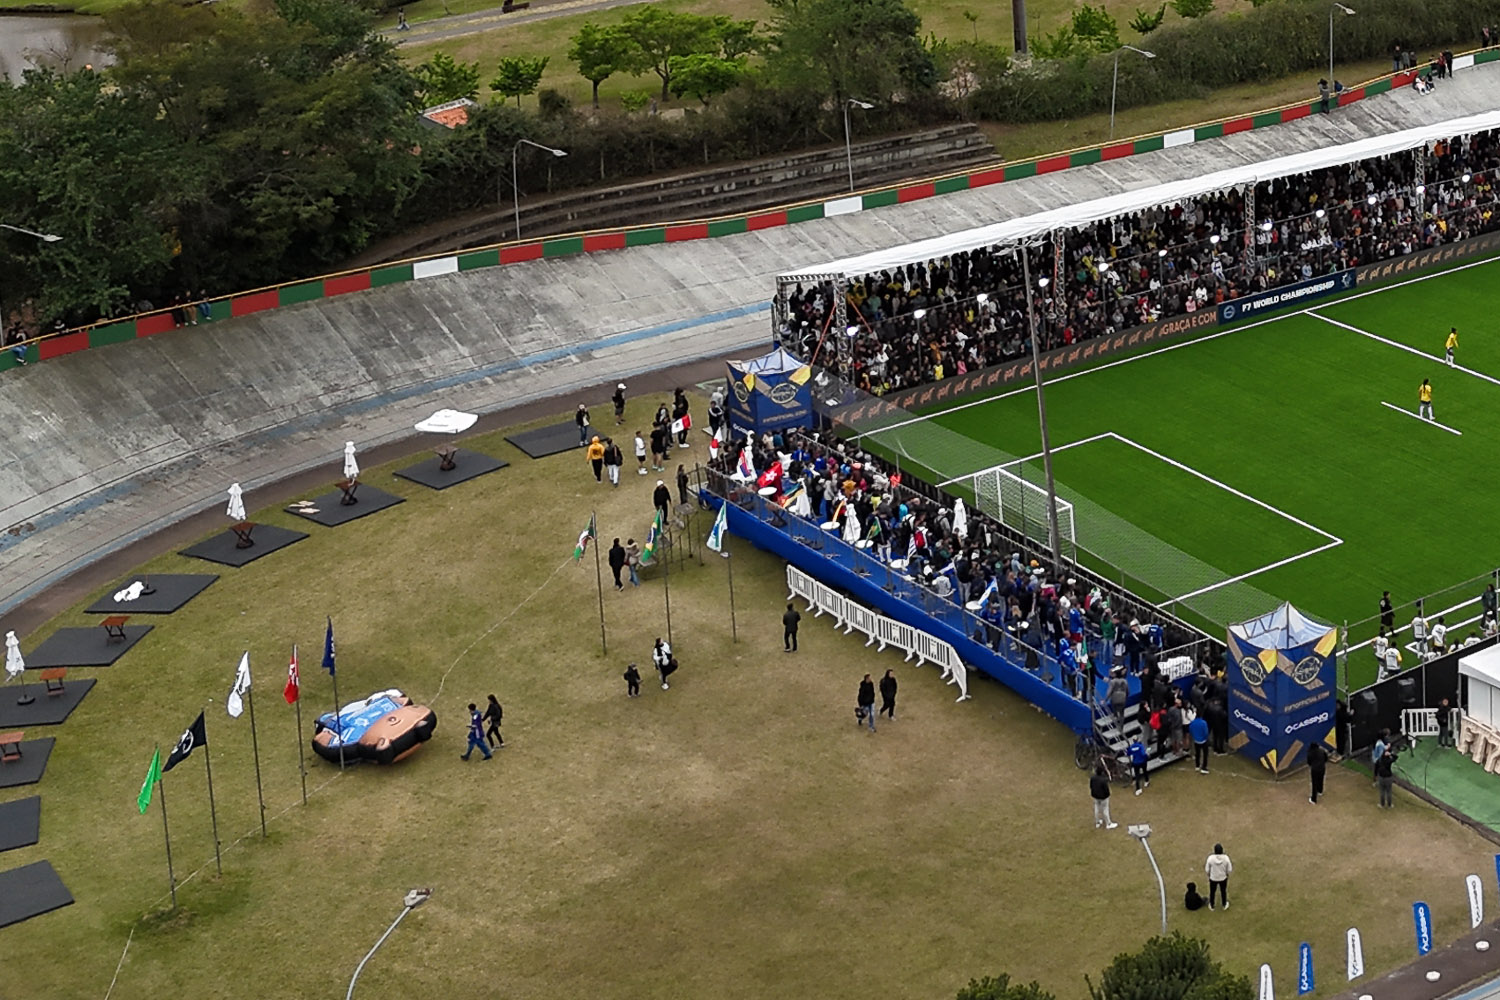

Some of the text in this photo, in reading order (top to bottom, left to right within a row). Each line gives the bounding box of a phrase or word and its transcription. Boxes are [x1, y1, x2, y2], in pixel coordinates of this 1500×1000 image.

[1242, 280, 1335, 312] F7 WORLD CHAMPIONSHIP
[1198, 311, 1217, 326] COM
